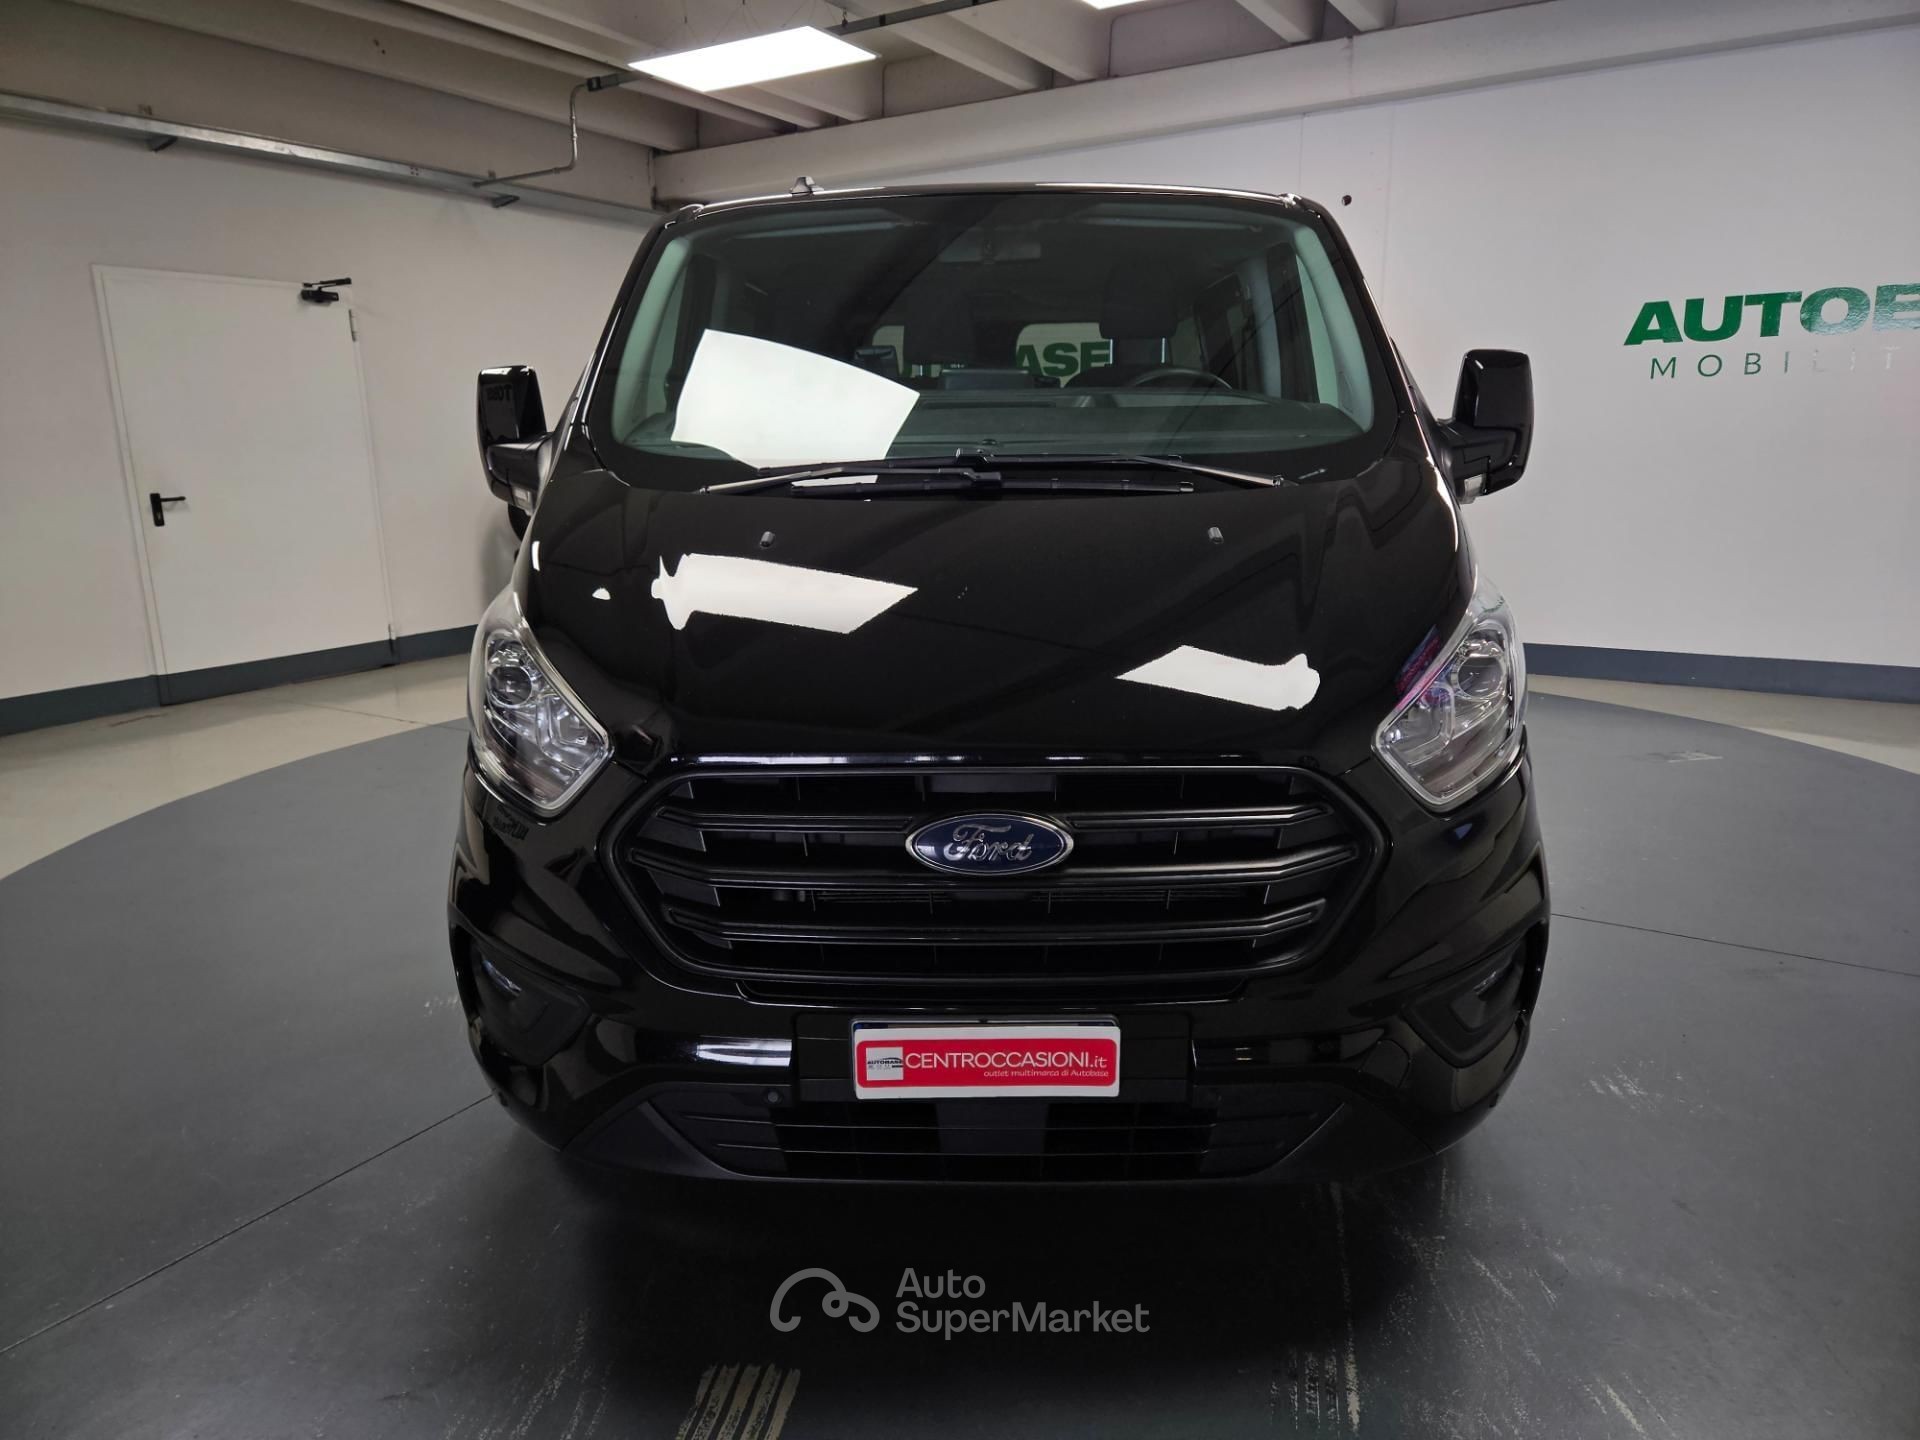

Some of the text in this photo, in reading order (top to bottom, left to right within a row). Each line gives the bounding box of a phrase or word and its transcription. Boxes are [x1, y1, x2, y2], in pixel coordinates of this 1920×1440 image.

[943, 823, 1034, 861] Ford
[905, 1051, 1107, 1069] CENTROCCASIONI.it
[1011, 1069, 1059, 1077] multimarca
[1071, 1069, 1109, 1077] Autobase
